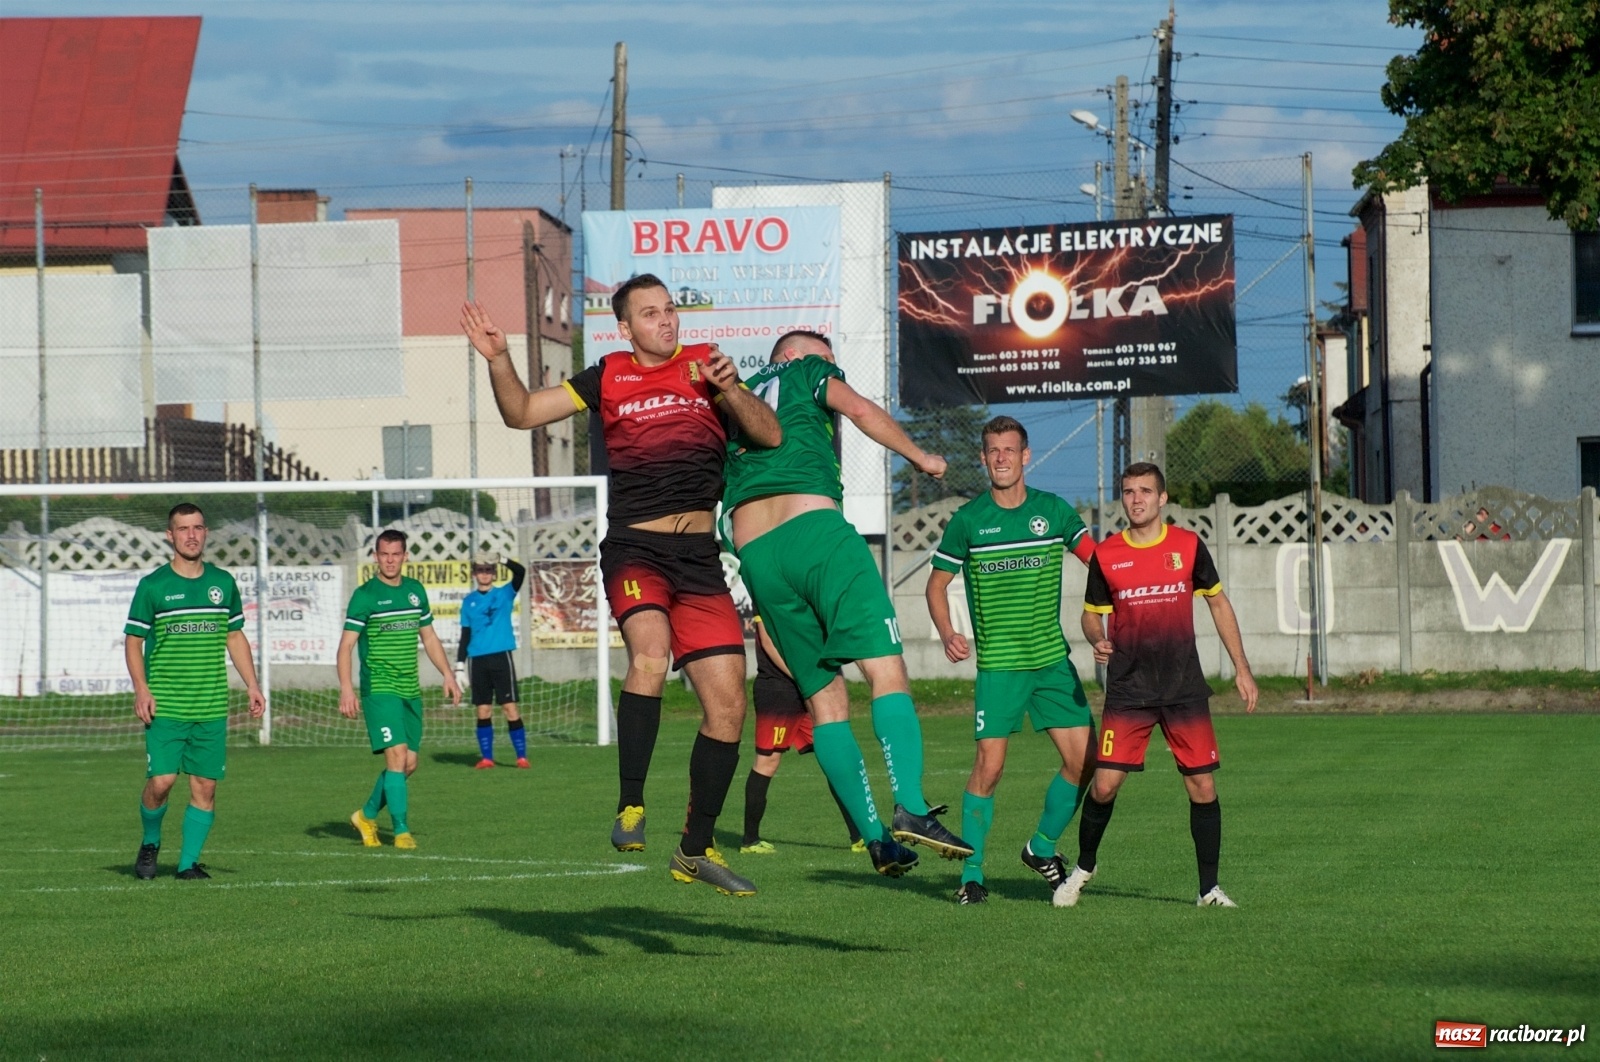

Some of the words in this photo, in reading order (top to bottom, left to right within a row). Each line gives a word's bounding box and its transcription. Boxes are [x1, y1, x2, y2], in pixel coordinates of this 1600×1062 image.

[632, 217, 790, 256] BRAVO
[910, 233, 1052, 260] INSTALACJE
[1060, 222, 1223, 252] ELEKTRYCZNE
[670, 266, 719, 283] DOM
[731, 262, 831, 281] WESELNY
[672, 288, 832, 307] RESTAURACJA
[972, 267, 1169, 340] FIOŁKA
[999, 351, 1018, 360] 603
[1021, 349, 1039, 359] 798
[1041, 348, 1060, 358] 977
[1115, 345, 1134, 354] 603
[1137, 343, 1155, 353] 798
[1158, 342, 1177, 352] 967
[739, 355, 766, 369] 606
[999, 363, 1019, 373] 605
[1021, 362, 1039, 372] 083
[1042, 361, 1061, 371] 762
[1117, 357, 1136, 367] 607
[1138, 356, 1157, 366] 336
[1160, 355, 1178, 364] 321
[622, 374, 643, 382] VIGO
[1005, 378, 1132, 396] www.fiolka.com.pl
[1117, 561, 1134, 569] VIGO
[623, 579, 642, 600] 4
[1118, 581, 1187, 600] mazur
[267, 609, 304, 621] MIG
[976, 710, 986, 732] 5
[380, 726, 393, 743] 3
[773, 726, 787, 746] 19
[1101, 729, 1115, 757] 6
